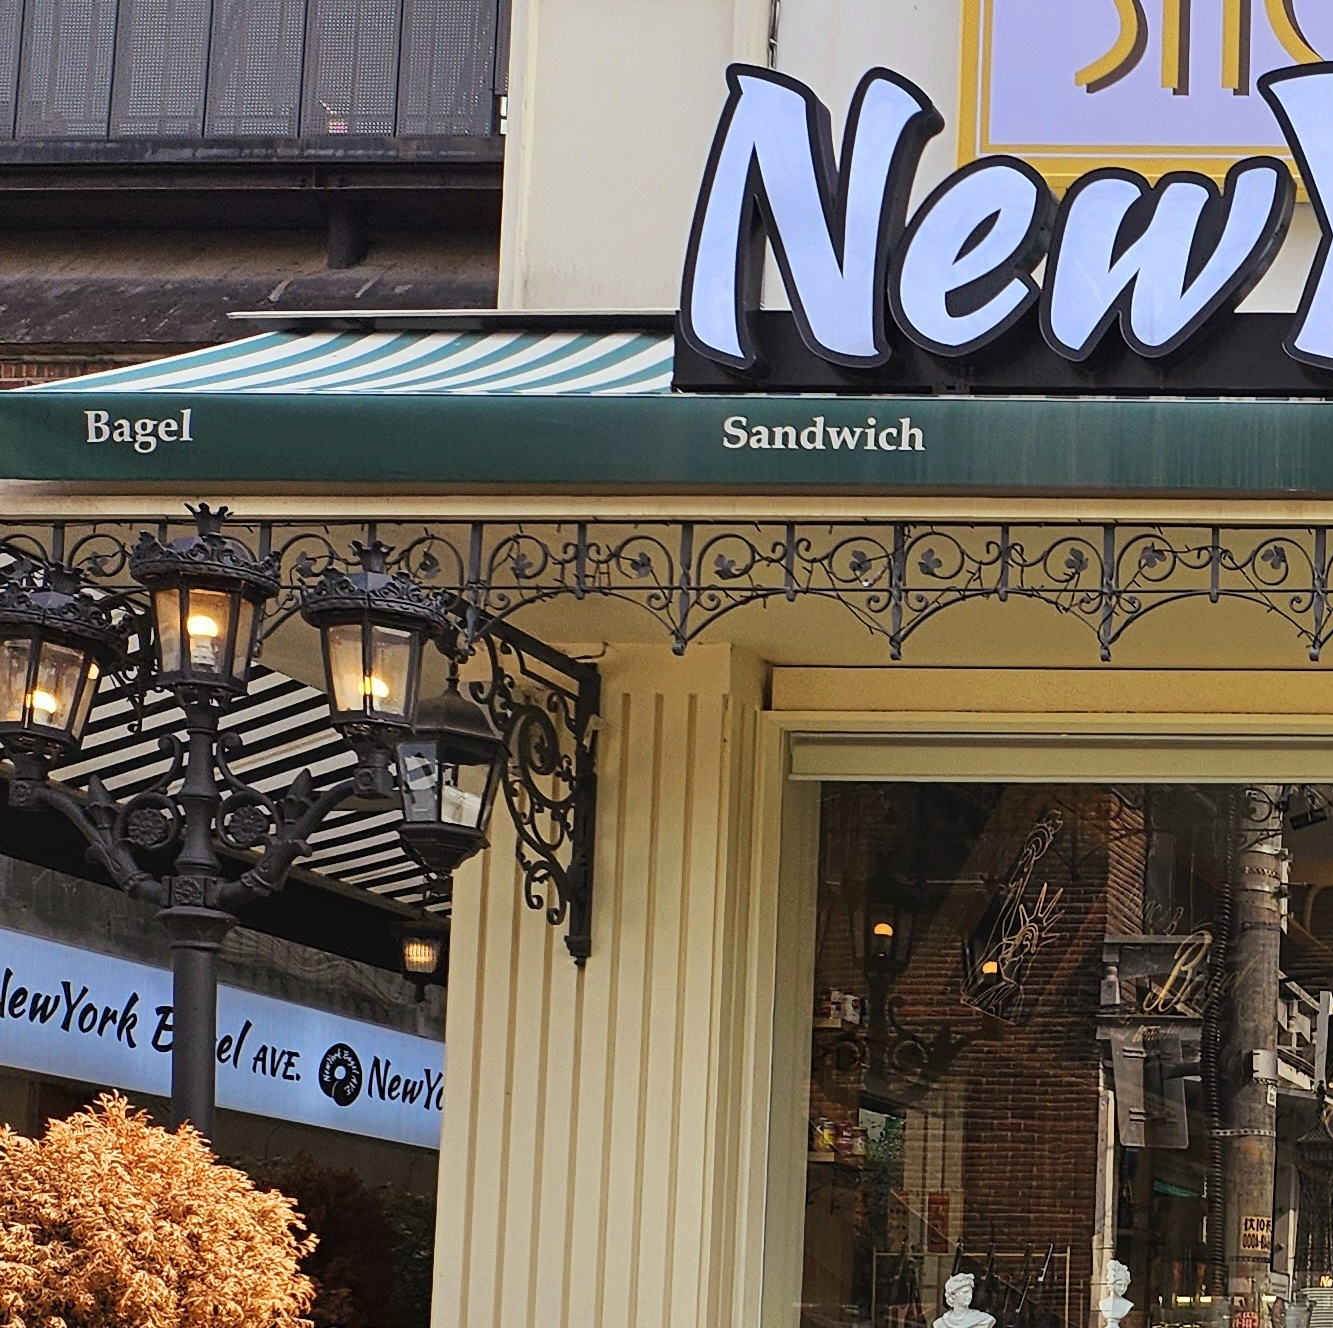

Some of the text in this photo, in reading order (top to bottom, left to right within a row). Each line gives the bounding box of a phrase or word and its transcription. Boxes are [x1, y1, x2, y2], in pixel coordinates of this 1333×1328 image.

[84, 407, 194, 454] Bagel
[722, 414, 926, 453] Sandwich
[151, 1005, 253, 1069] Bel
[252, 1043, 301, 1082] AVE.
